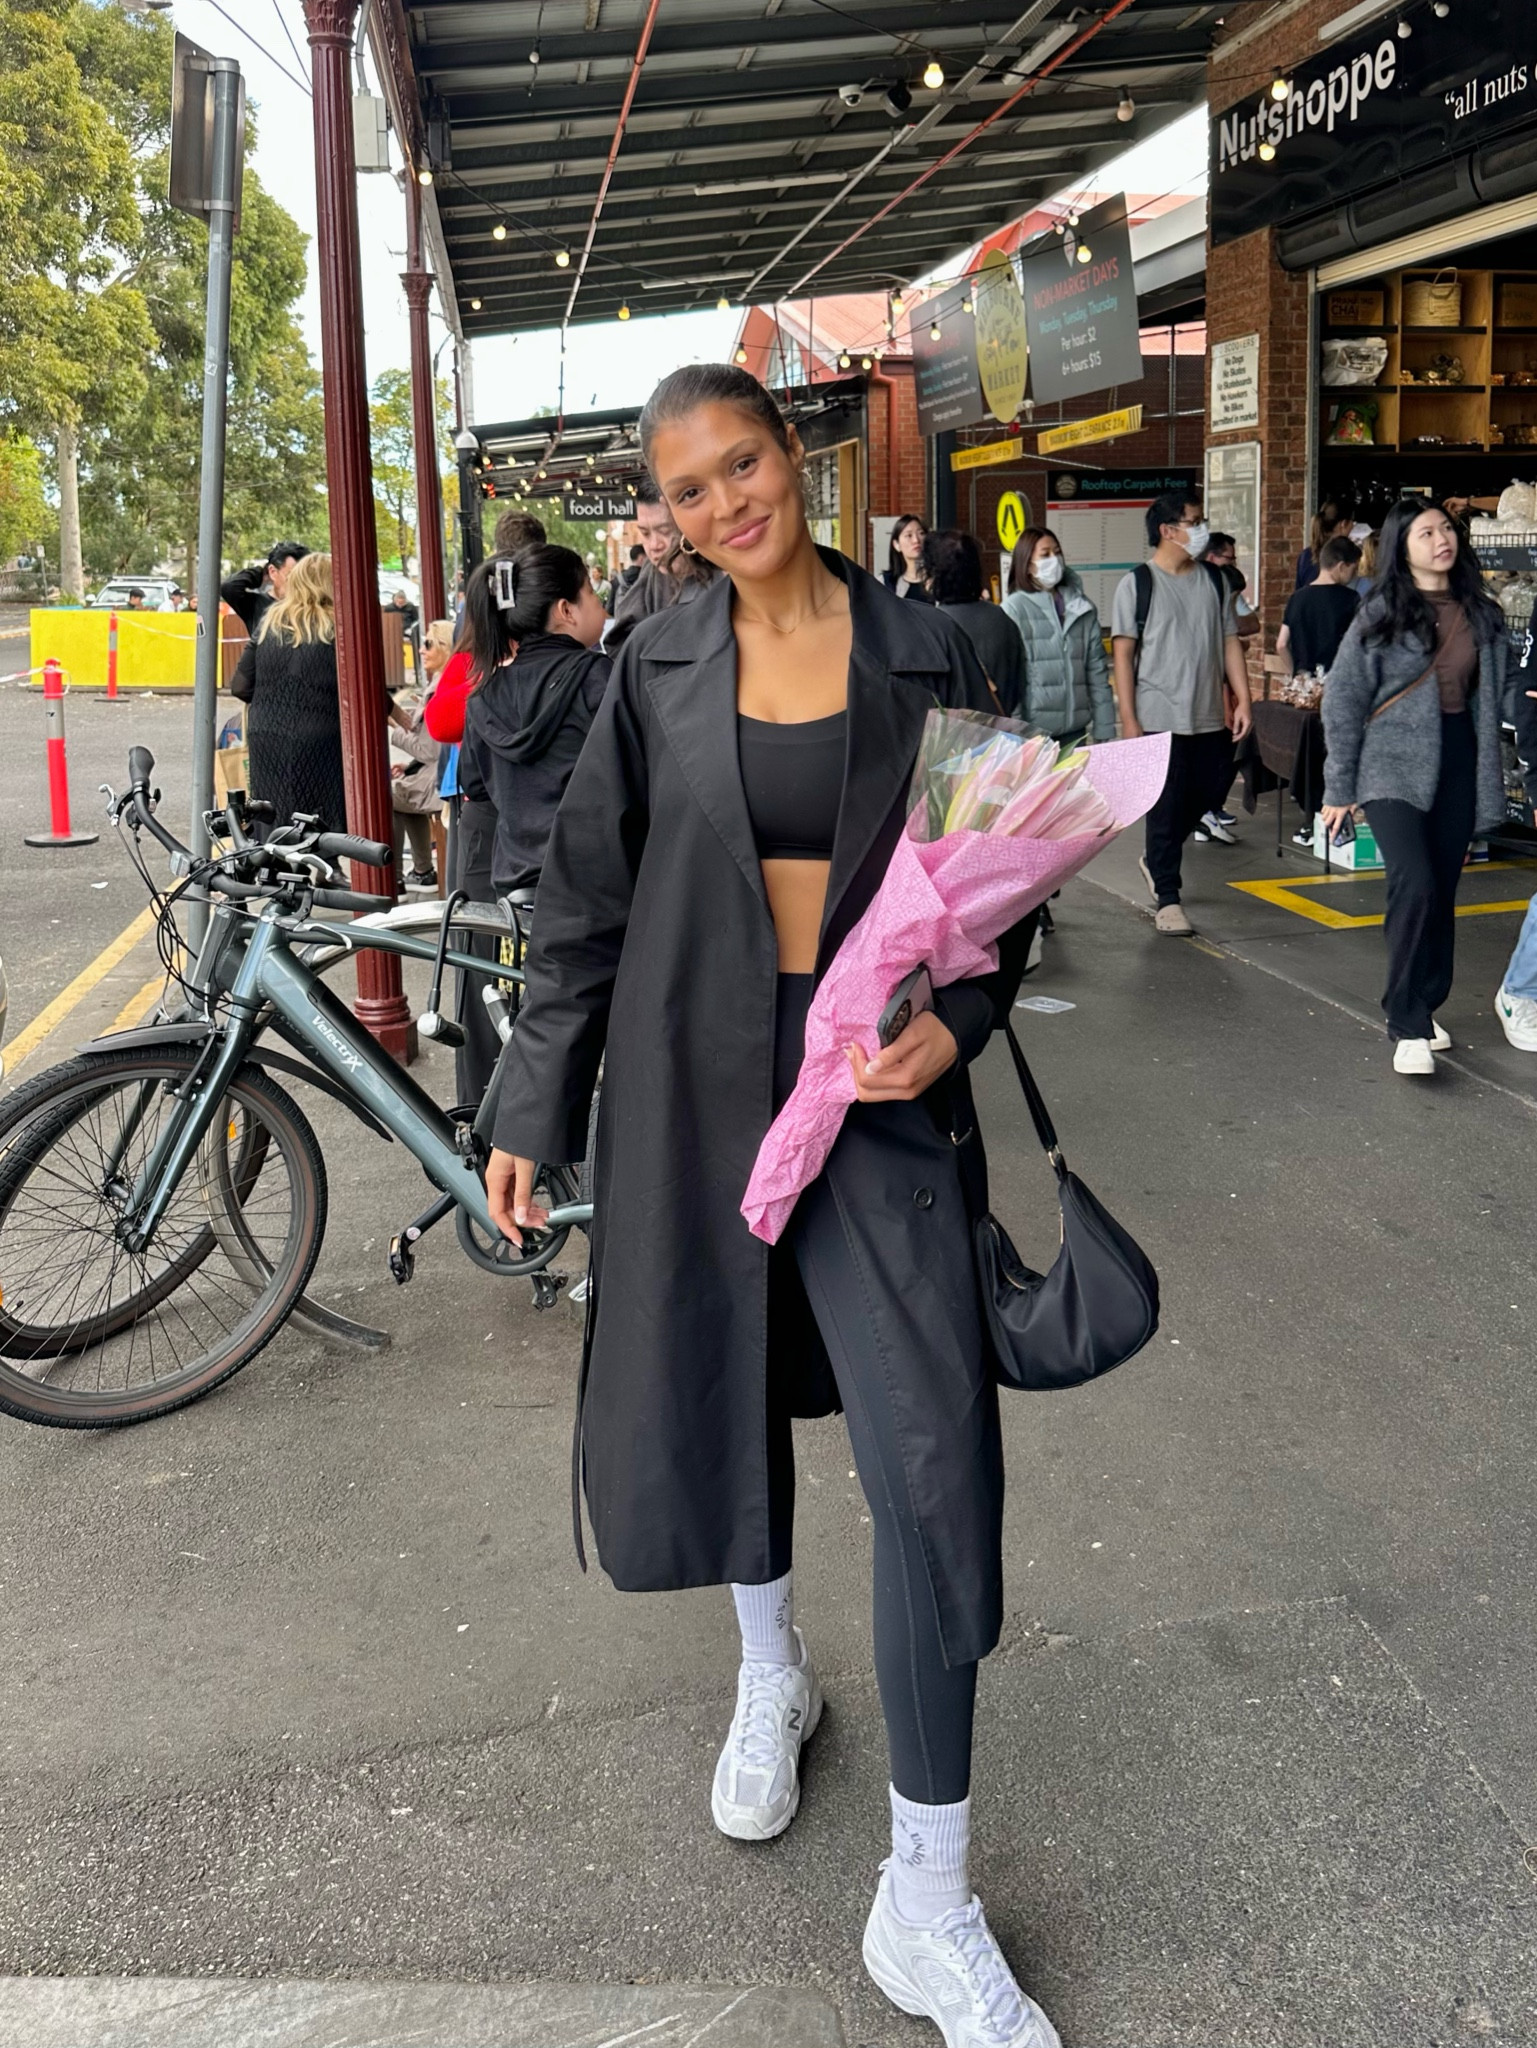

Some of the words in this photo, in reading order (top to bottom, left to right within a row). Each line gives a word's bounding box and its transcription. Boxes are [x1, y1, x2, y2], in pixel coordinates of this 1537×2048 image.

[1484, 63, 1528, 107] nuts
[1219, 39, 1396, 173] Nutshoppe
[1033, 269, 1091, 312] NON-MARKET
[1093, 257, 1120, 287] DAYS
[1088, 326, 1097, 343] $2
[1089, 351, 1101, 368] $15
[1224, 357, 1232, 366] No
[1223, 370, 1230, 378] No
[1081, 479, 1122, 493] Rooftop
[1123, 478, 1162, 493] Carpark
[1164, 477, 1188, 489] Fees
[569, 498, 604, 516] food
[608, 498, 634, 516] hall
